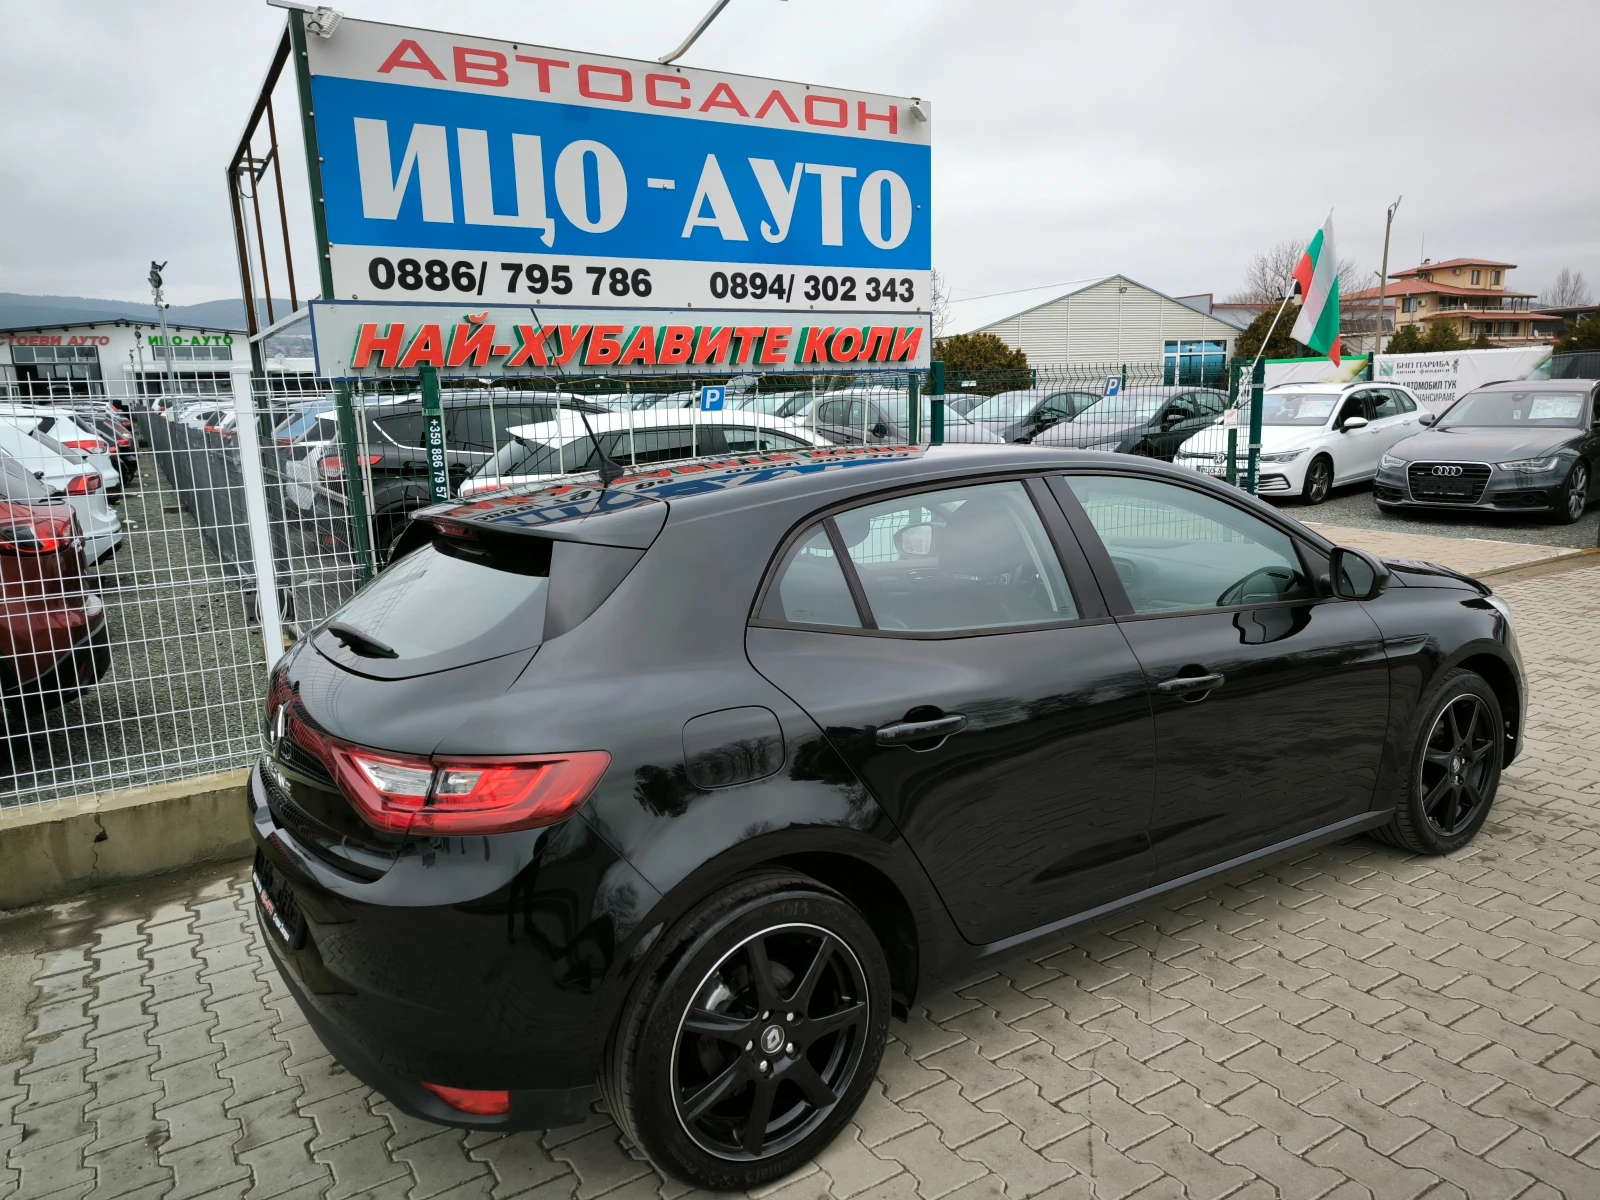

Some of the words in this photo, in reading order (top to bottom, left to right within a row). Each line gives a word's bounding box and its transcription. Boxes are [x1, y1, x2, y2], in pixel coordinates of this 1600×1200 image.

[377, 38, 898, 134] АВТОСАЛОН
[368, 257, 488, 295] 0886/
[500, 263, 573, 295] 795
[586, 266, 652, 297] 786
[710, 271, 795, 303] 0894/
[804, 275, 856, 301] 302
[865, 277, 915, 302] 343
[67, 335, 110, 346] АУТО
[350, 311, 793, 369] НАЙ-ХУБАВИТЕ
[794, 326, 923, 364] КОЛИ
[1415, 360, 1450, 369] ПАРИБА
[1106, 378, 1118, 395] P
[1444, 380, 1457, 390] ТУК
[705, 389, 720, 409] P
[429, 418, 441, 446] +359
[431, 448, 444, 468] 886
[434, 470, 446, 483] 79
[436, 486, 448, 499] 57
